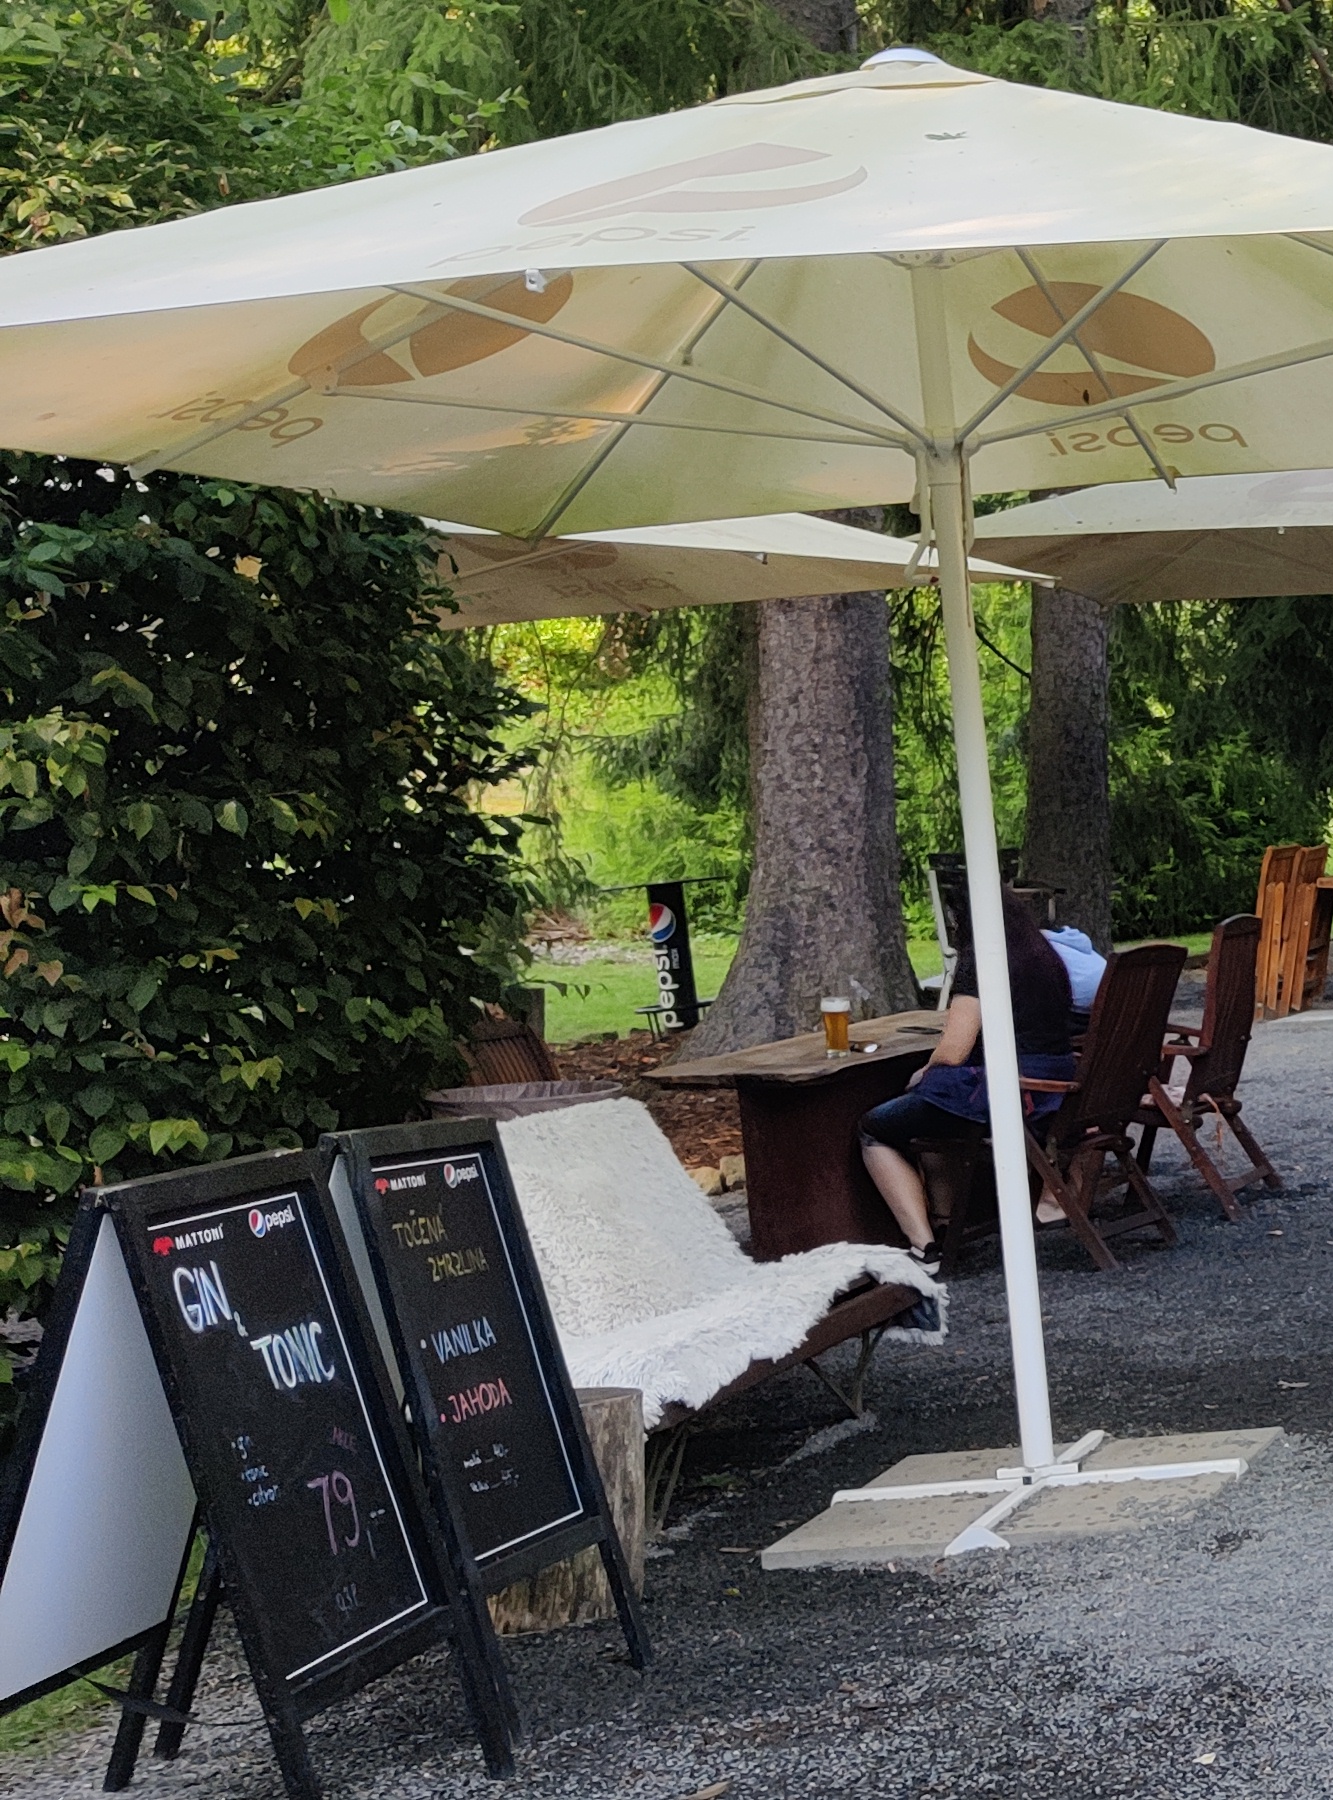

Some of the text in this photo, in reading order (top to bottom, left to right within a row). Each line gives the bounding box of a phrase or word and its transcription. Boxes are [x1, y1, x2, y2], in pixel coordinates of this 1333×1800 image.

[653, 944, 684, 1029] pepsi
[389, 1171, 427, 1191] MATTONI
[455, 1163, 479, 1184] pepsi
[174, 1222, 224, 1251] MATTONI
[264, 1203, 295, 1231] pepsi
[171, 1260, 233, 1334] GIN
[250, 1320, 336, 1391] TONIC
[431, 1316, 497, 1364] VANILKA
[447, 1377, 513, 1425] JAHODA
